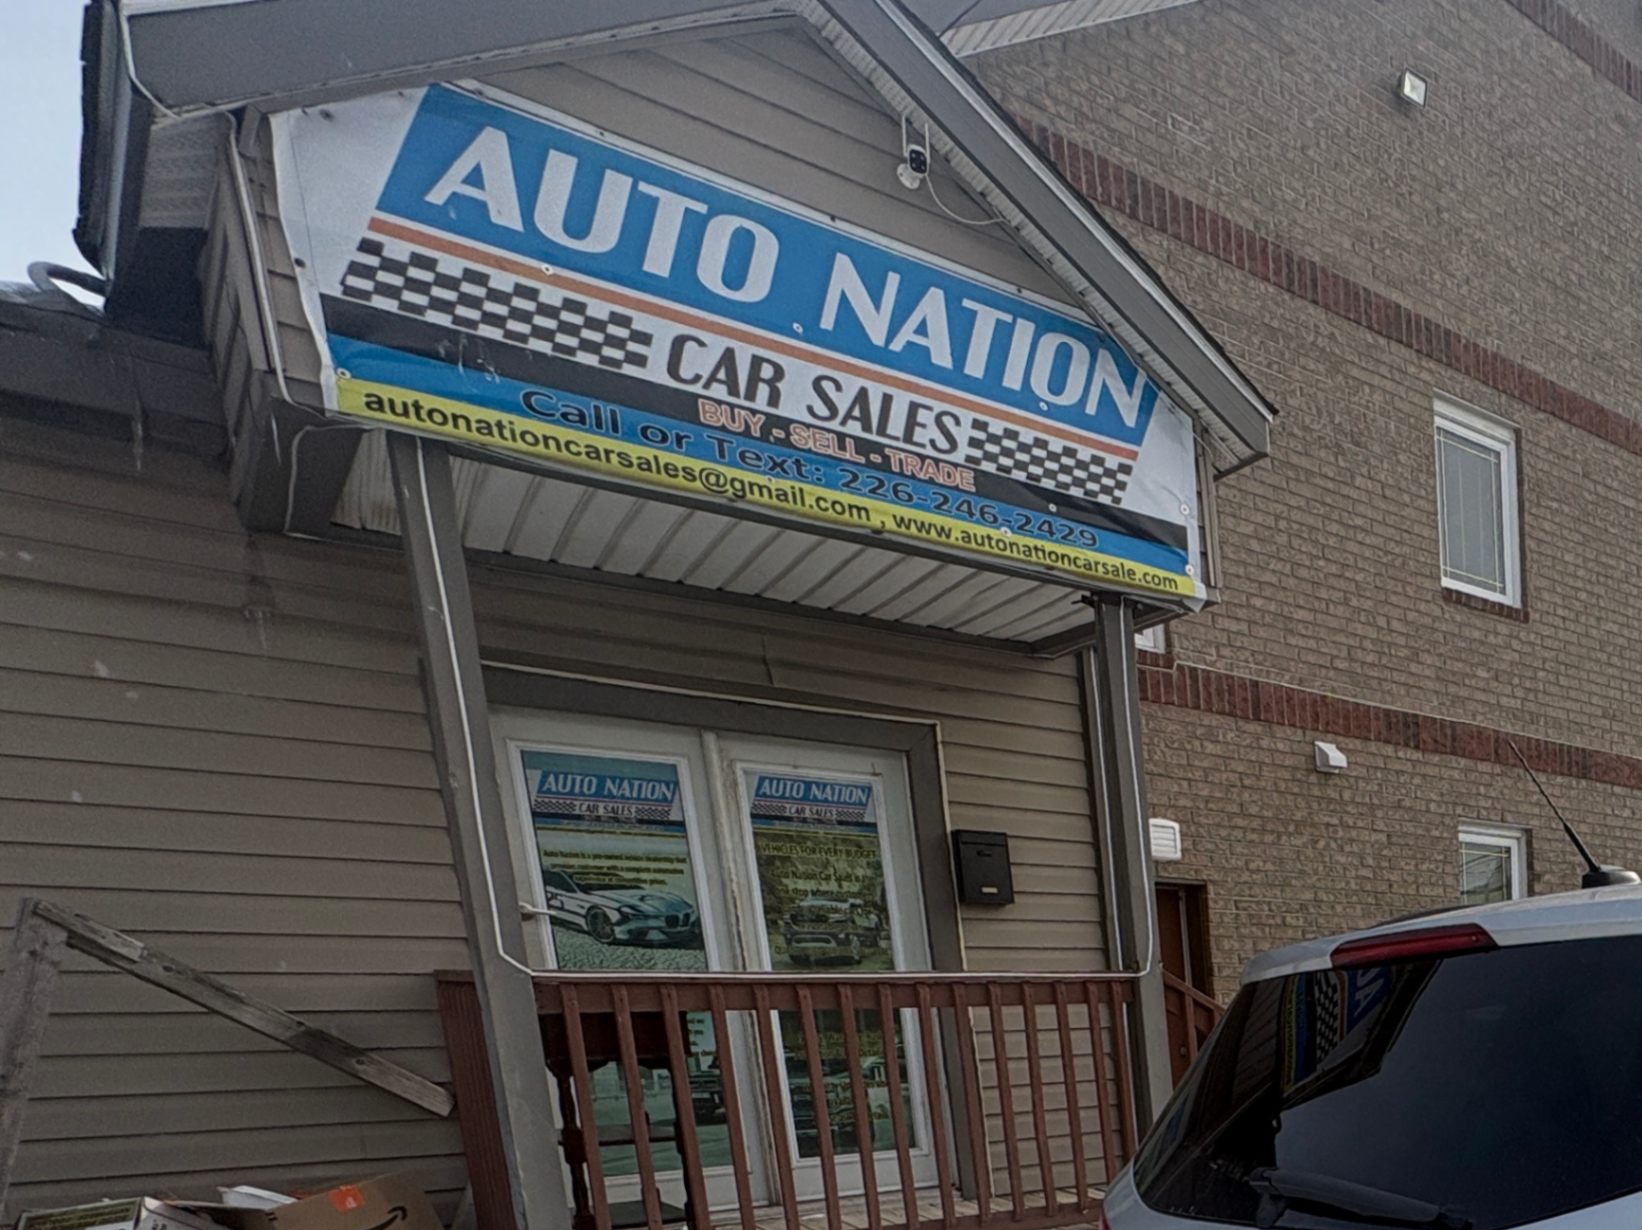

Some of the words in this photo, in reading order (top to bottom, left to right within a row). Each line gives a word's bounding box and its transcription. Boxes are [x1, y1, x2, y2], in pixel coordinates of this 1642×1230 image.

[423, 125, 780, 303] AUTO
[819, 252, 1150, 429] NATION
[665, 332, 785, 409] CAR
[806, 374, 962, 455] SALES
[363, 391, 871, 523] autonationcarsales@gmail.com
[892, 511, 1179, 591] www.autonationcarsale.com
[519, 388, 622, 436] Call
[639, 421, 694, 452] or
[704, 434, 824, 483] Text:
[838, 466, 1099, 549] 226-246-2429
[697, 398, 766, 438] BUY
[789, 424, 867, 464] SELL
[884, 448, 978, 491] TRADE
[542, 772, 597, 795] AUTO
[604, 776, 675, 801] NATION
[578, 802, 600, 814] CAR
[602, 804, 634, 817] SALES
[758, 778, 805, 798] AUTO
[810, 783, 869, 804] NATION
[788, 805, 807, 816] CAR
[809, 807, 835, 818] SALES
